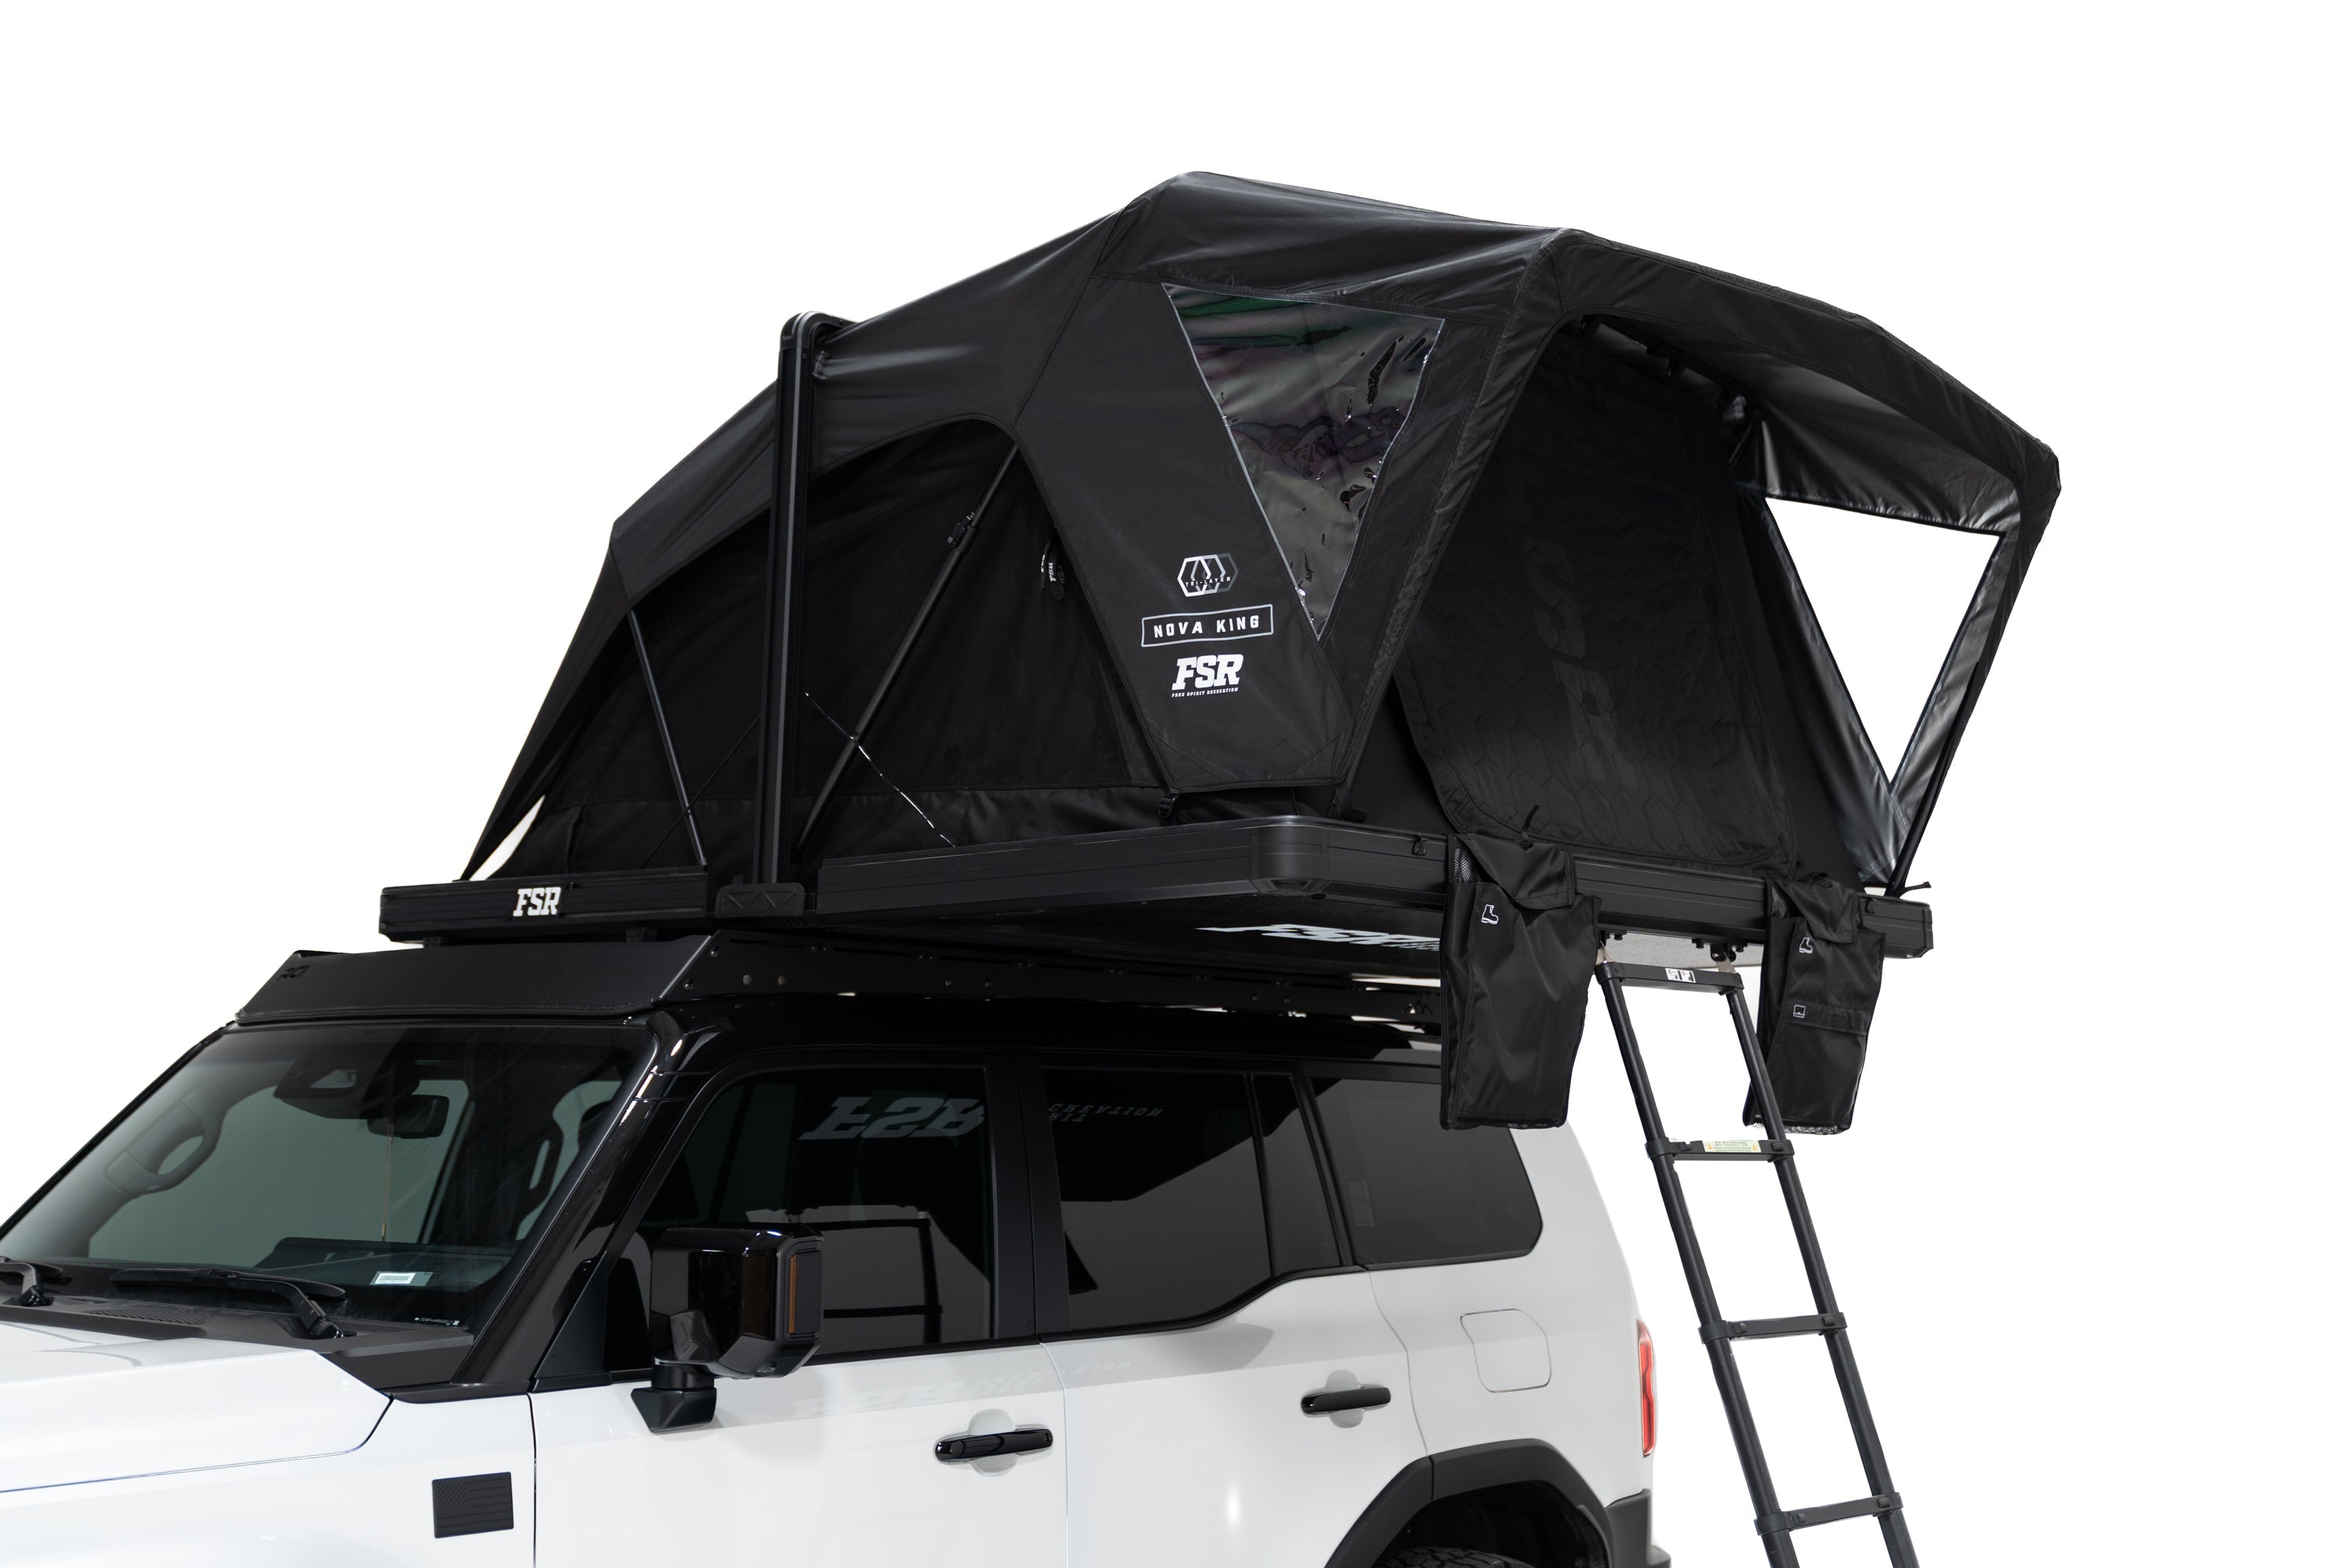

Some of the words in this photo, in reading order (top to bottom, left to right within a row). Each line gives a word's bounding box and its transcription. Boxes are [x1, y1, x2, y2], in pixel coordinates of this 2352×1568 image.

[1185, 576, 1232, 587] TRI-LAYER
[1153, 621, 1203, 638] NOVA
[1216, 615, 1261, 633] KING
[1171, 654, 1244, 691] FSR
[513, 887, 561, 916] FSR
